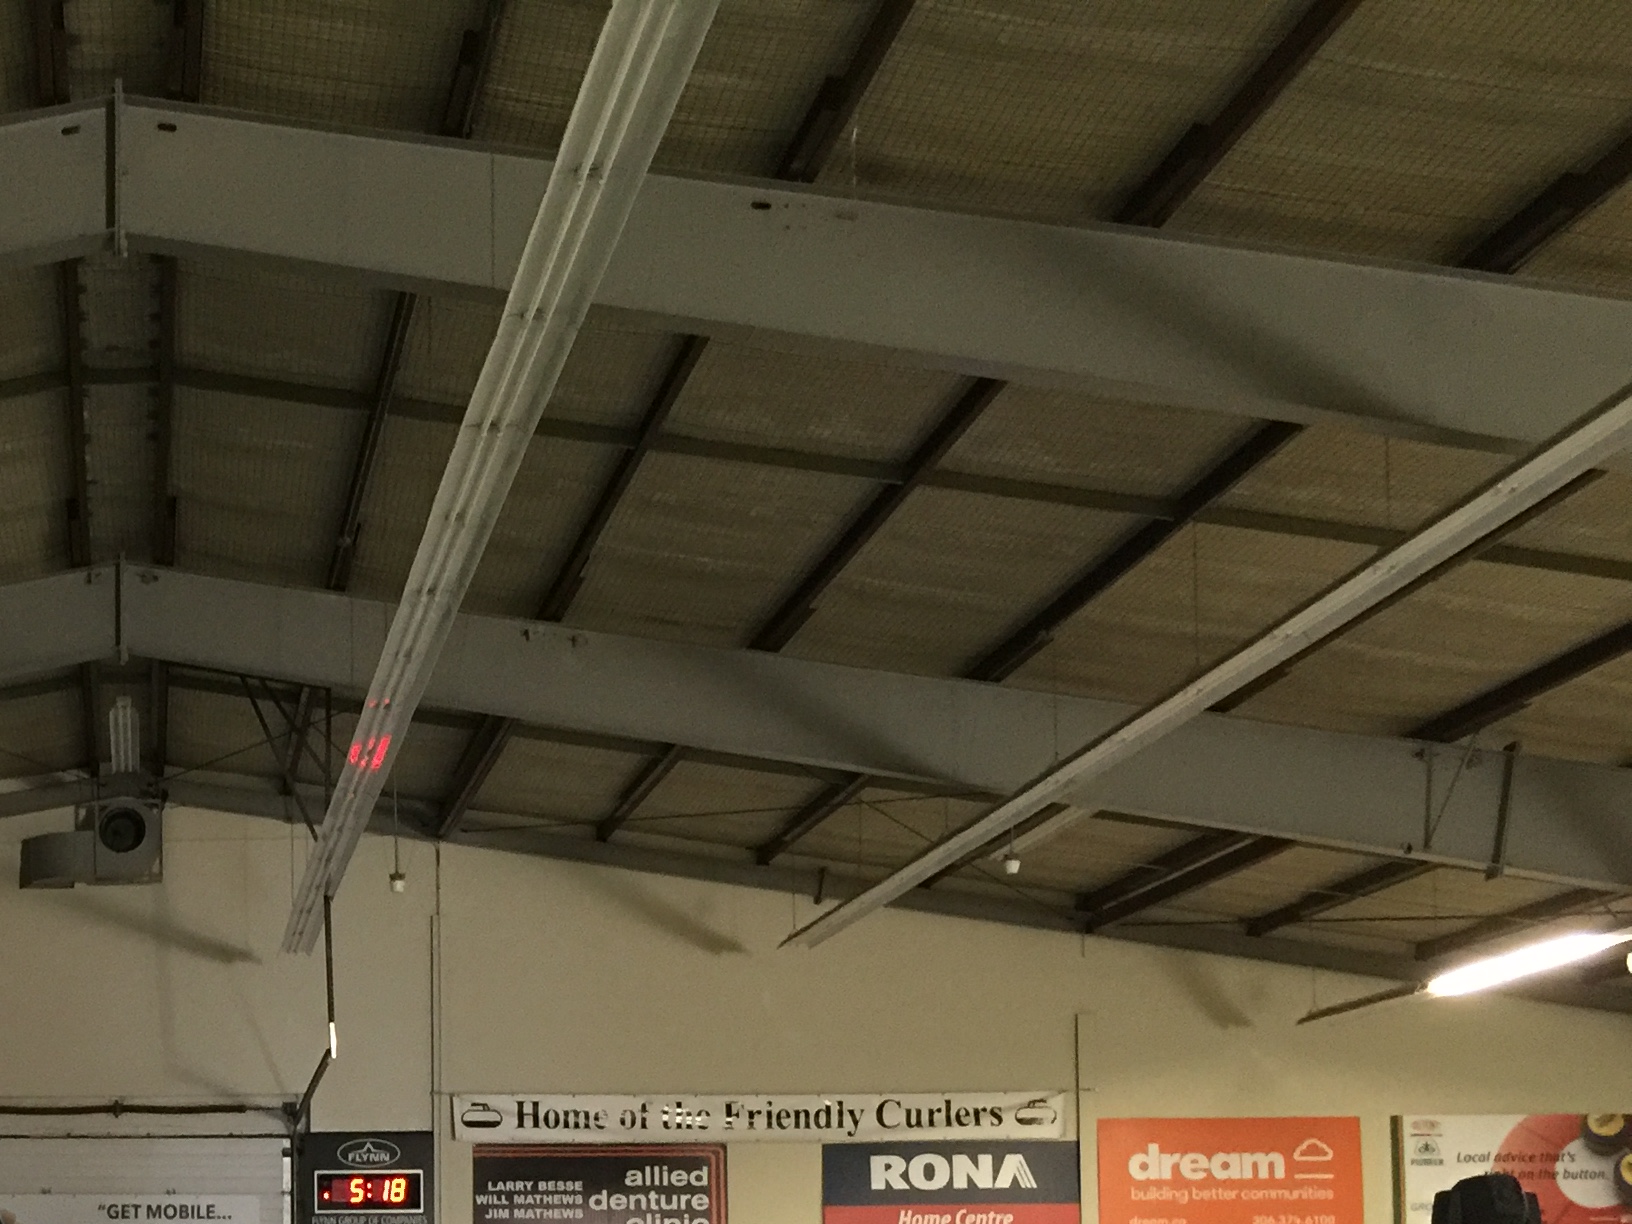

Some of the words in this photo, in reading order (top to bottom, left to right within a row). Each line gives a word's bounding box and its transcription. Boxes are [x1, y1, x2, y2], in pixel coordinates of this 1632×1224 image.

[515, 1101, 608, 1129] Home
[619, 1102, 653, 1130] of
[661, 1101, 711, 1129] the
[724, 1101, 865, 1137] Friendly
[876, 1099, 1004, 1129] Curlers
[348, 1152, 390, 1162] FLYNN
[1128, 1143, 1285, 1181] dream
[1456, 1151, 1491, 1164] Local
[1493, 1151, 1536, 1164] advice
[1537, 1151, 1577, 1164] that's
[624, 1166, 709, 1187] allied
[870, 1153, 1037, 1190] RONA
[1518, 1170, 1535, 1180] on
[1538, 1169, 1558, 1180] the
[349, 1178, 406, 1203] 5:18
[487, 1180, 533, 1191] LARRY
[538, 1180, 583, 1191] BESSE
[1130, 1187, 1189, 1204] building
[1191, 1187, 1239, 1200] better
[1240, 1185, 1334, 1200] communities
[475, 1195, 508, 1205] WILL
[514, 1194, 583, 1205] MATHEWS
[588, 1189, 709, 1211] denture
[484, 1208, 509, 1219] JIM
[514, 1208, 583, 1219] MATHEWS
